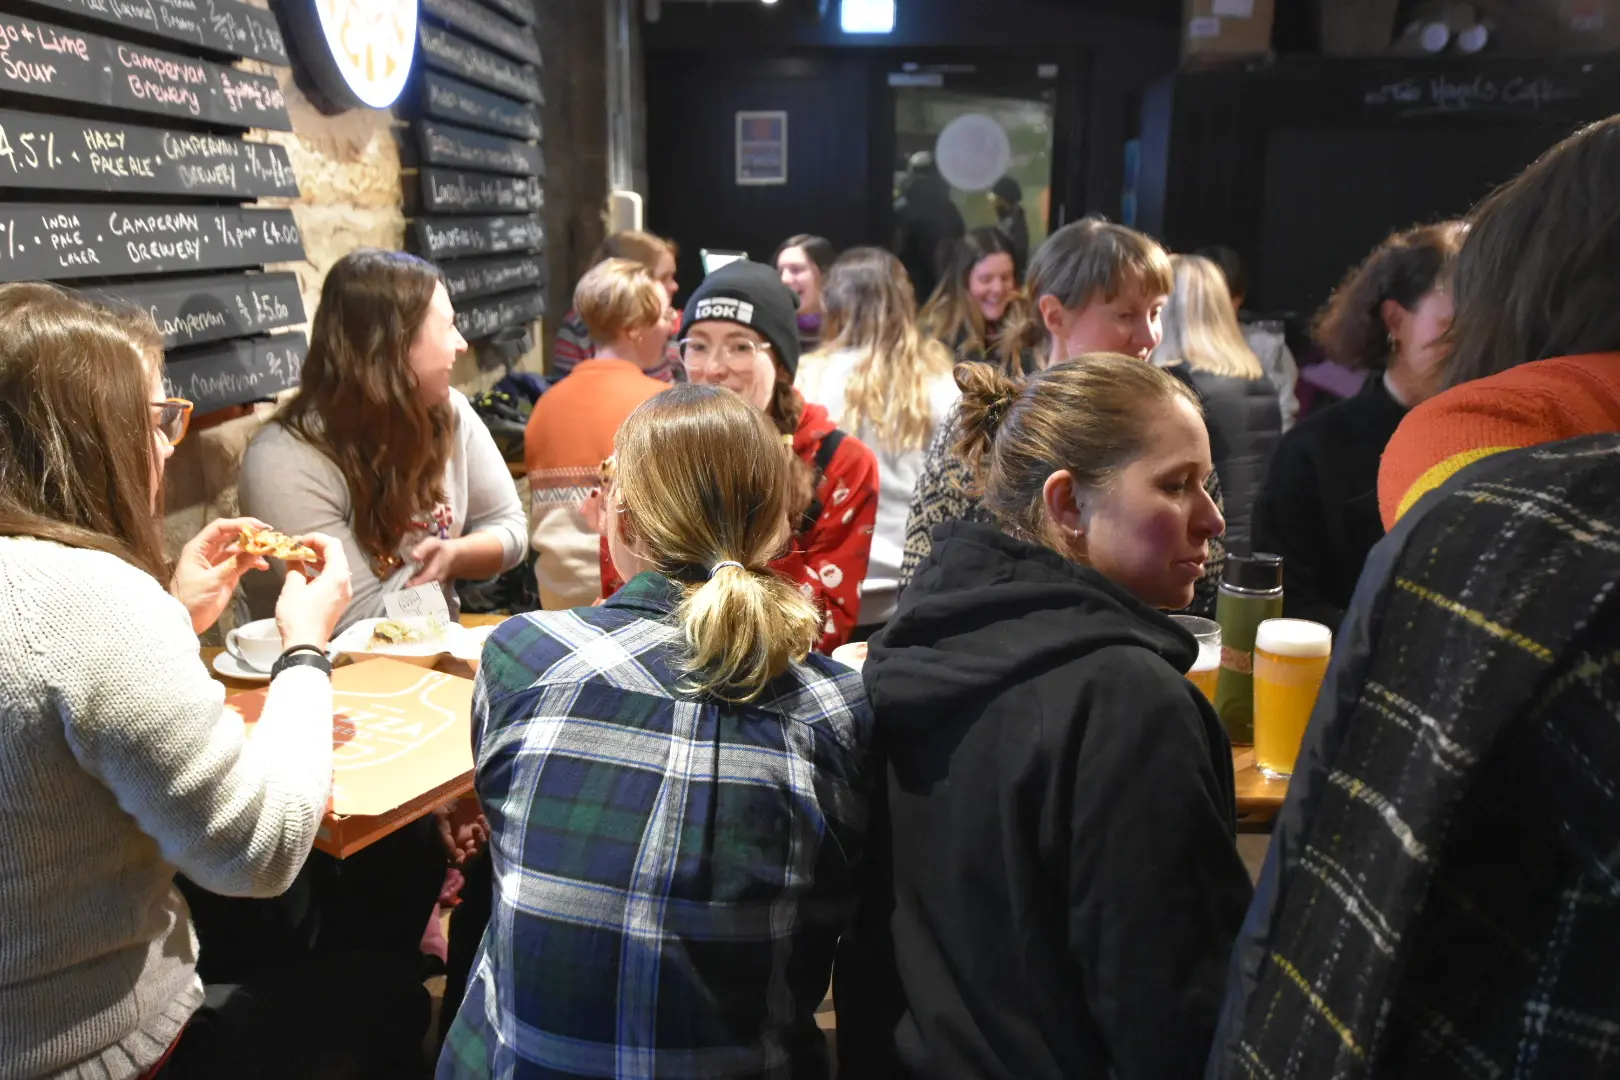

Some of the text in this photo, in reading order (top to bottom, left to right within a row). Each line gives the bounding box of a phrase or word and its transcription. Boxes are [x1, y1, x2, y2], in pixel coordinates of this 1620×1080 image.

[0, 51, 57, 84] Sour
[117, 45, 207, 84] Campervan
[127, 74, 200, 116] Brewery
[83, 128, 125, 152] HAZY
[89, 151, 155, 178] PALE ALE
[42, 213, 80, 230] INDIA
[109, 211, 199, 236] CAMPERVAN
[50, 230, 83, 251] PALE
[126, 239, 200, 263] BREWERY
[59, 247, 101, 267] LAGER
[150, 304, 226, 339] Campervan
